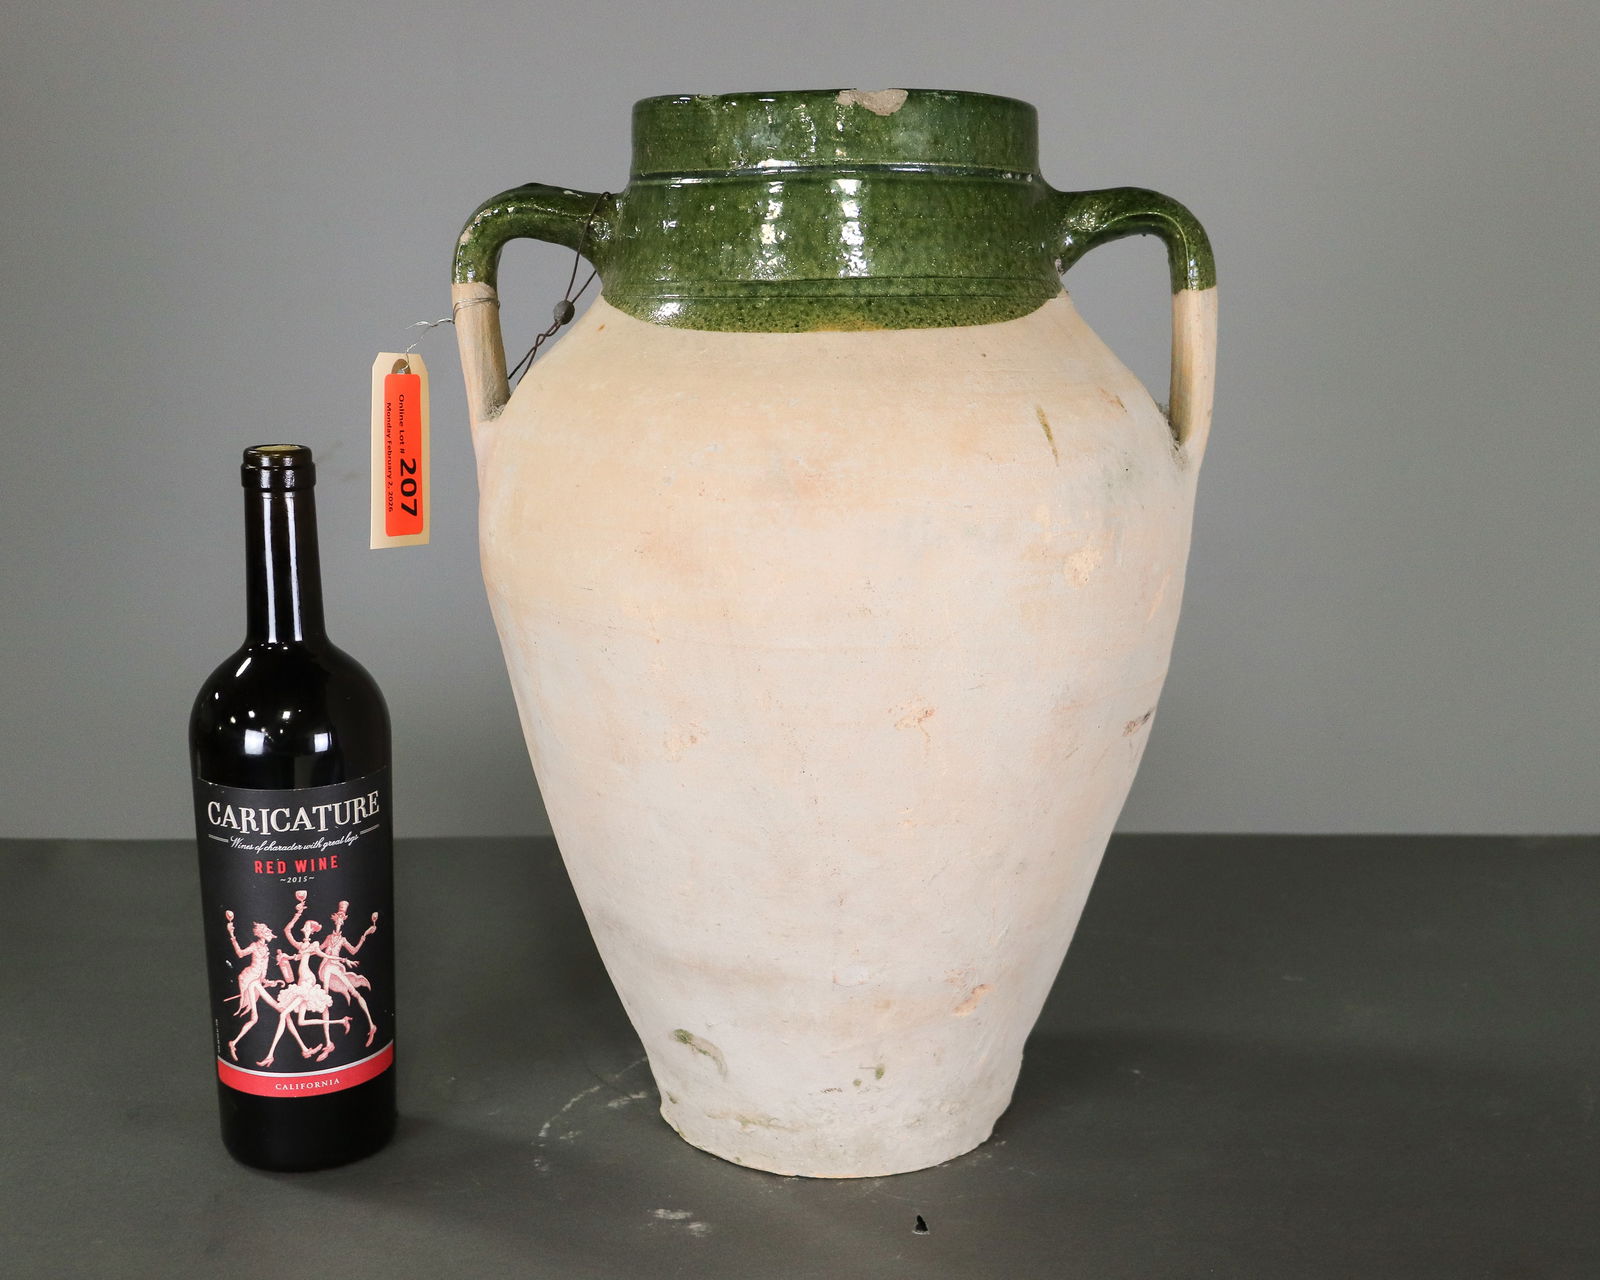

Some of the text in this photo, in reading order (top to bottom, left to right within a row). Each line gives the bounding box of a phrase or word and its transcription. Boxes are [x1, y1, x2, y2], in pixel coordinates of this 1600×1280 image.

[400, 458, 418, 517] 207
[207, 790, 380, 836] CARICATURE
[229, 831, 359, 854] Wines of character with great legs
[254, 855, 339, 875] RED WINE
[275, 1078, 341, 1091] CALIFORNIA
